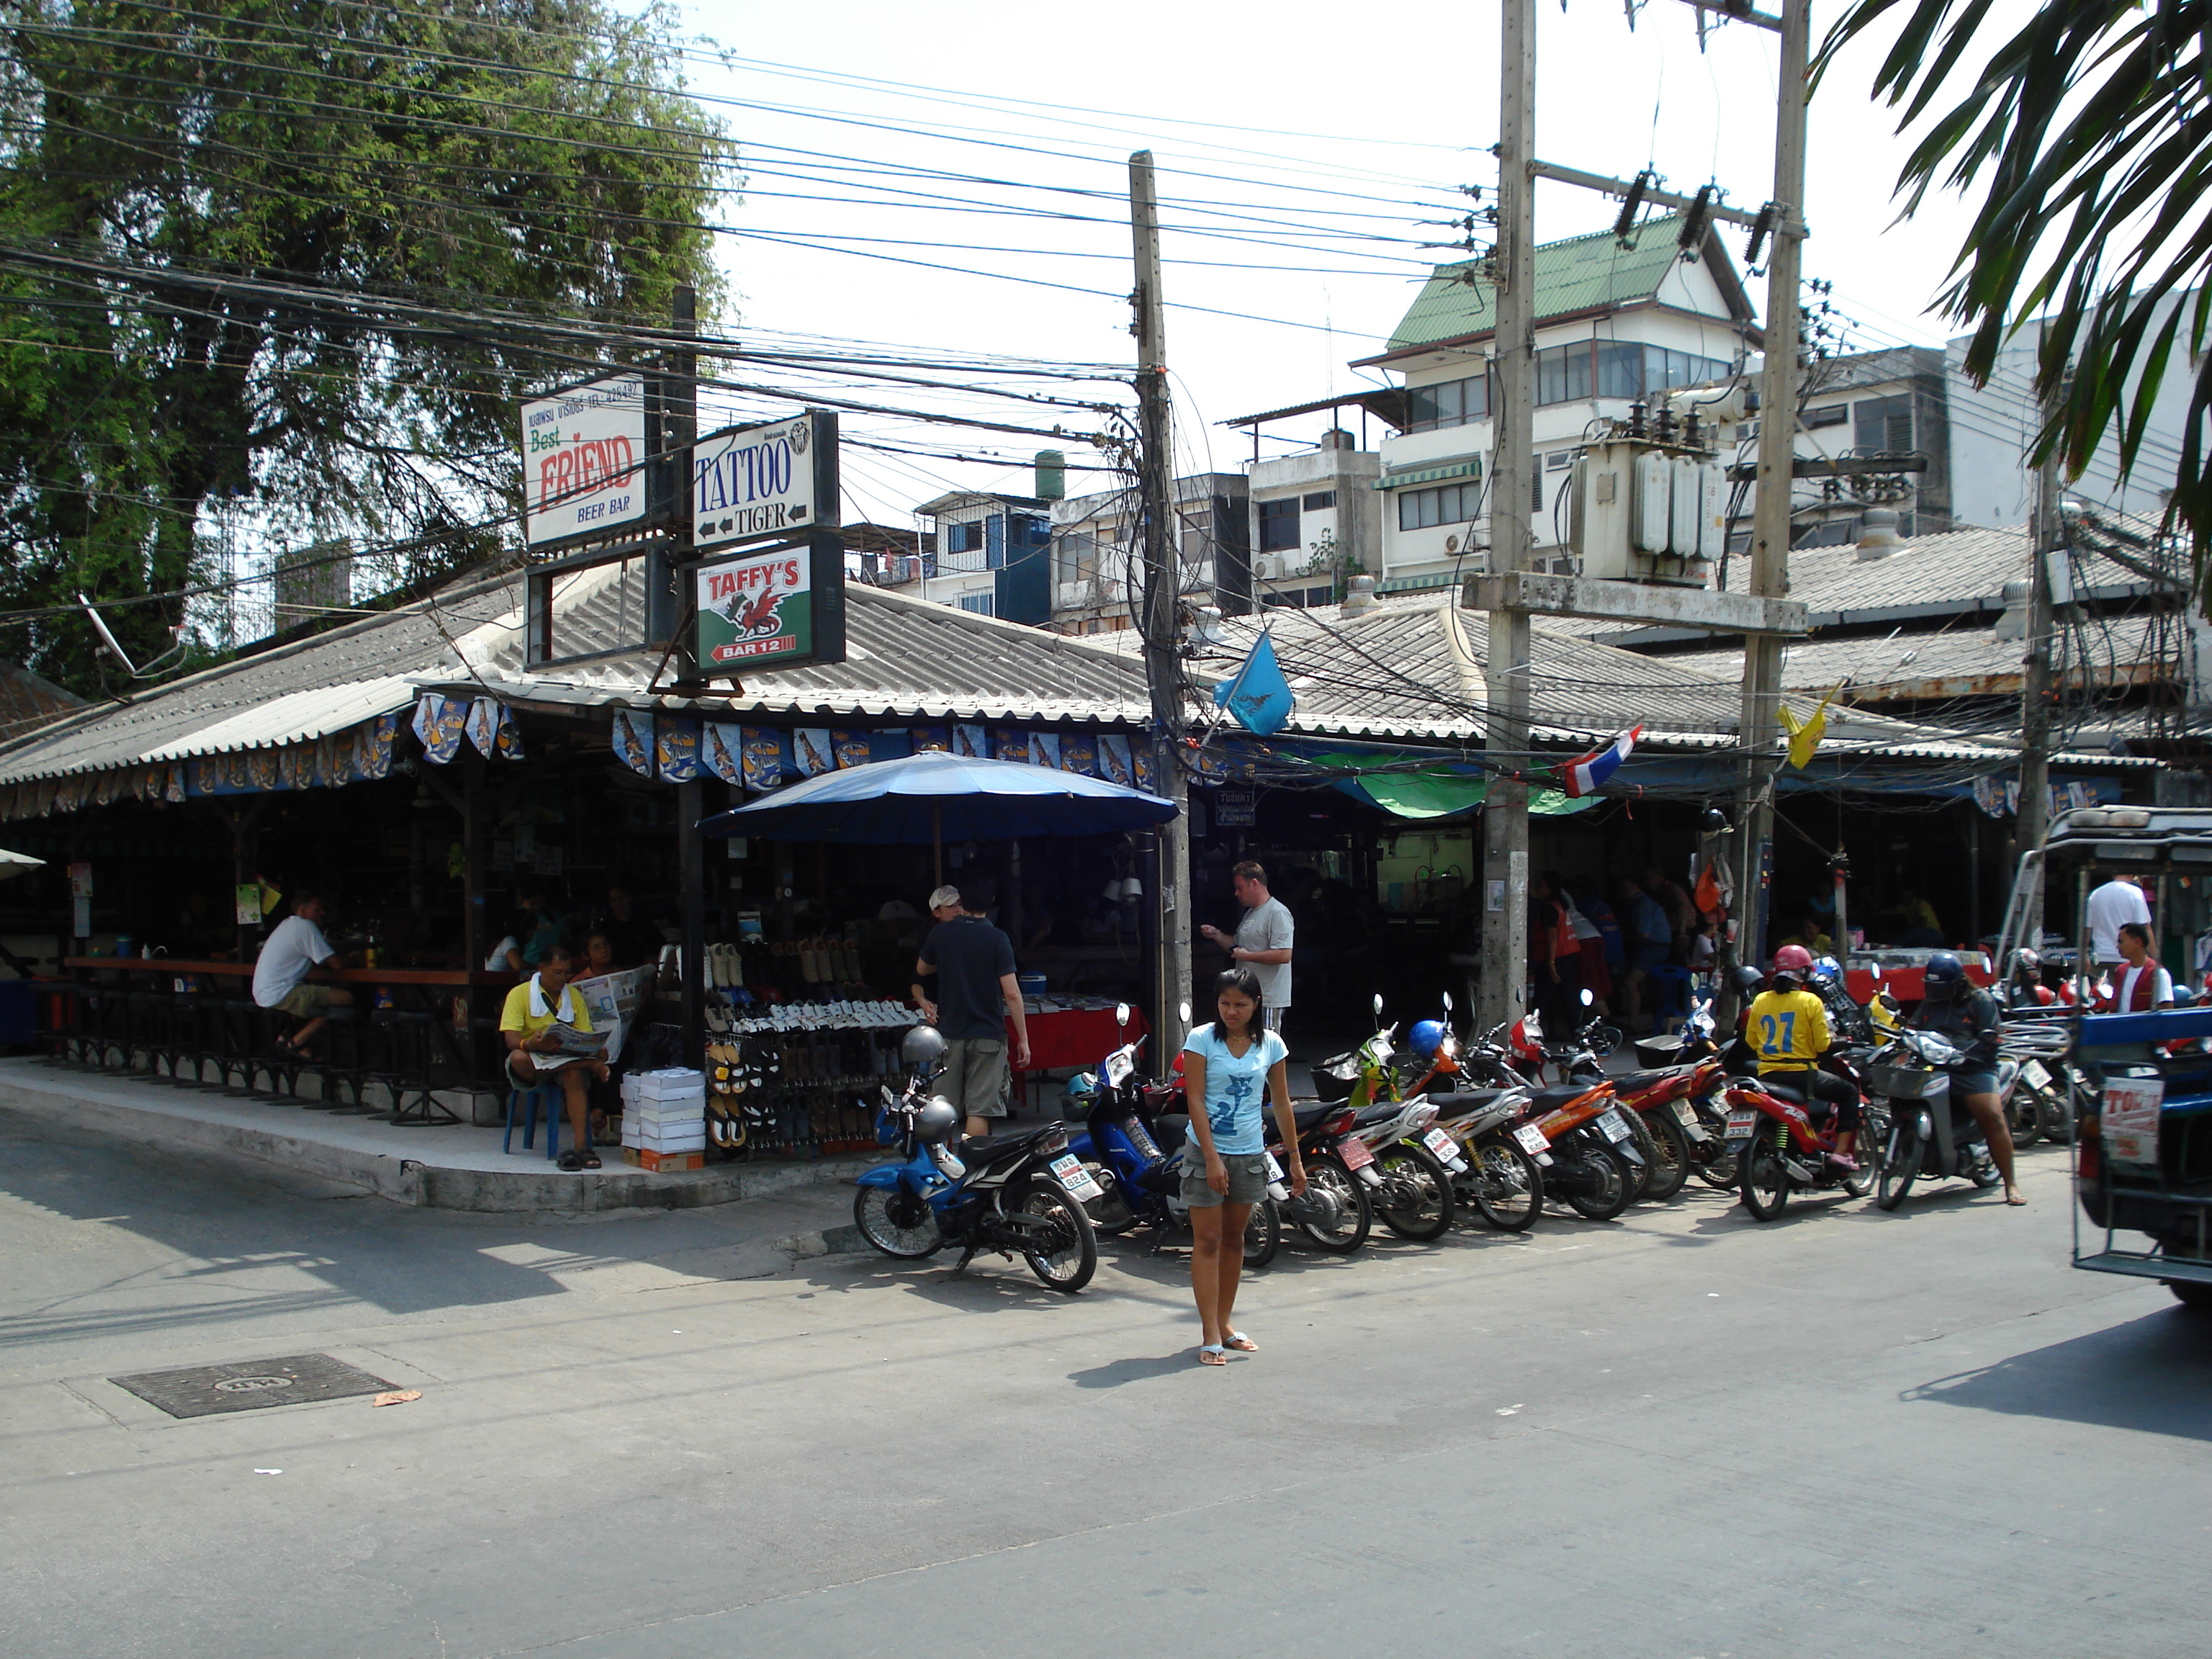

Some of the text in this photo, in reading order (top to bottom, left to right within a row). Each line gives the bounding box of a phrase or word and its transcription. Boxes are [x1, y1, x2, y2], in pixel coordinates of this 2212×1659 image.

[530, 426, 561, 453] Best
[696, 439, 791, 513] TATTOO
[577, 496, 630, 523] BEER BAR
[735, 503, 787, 535] TIGER
[708, 559, 799, 601] TAFFY'S
[722, 640, 780, 658] BAR 12
[1760, 1012, 1795, 1054] 27
[1729, 1128, 1748, 1136] 332
[1440, 1148, 1456, 1160] 335
[1529, 1141, 1546, 1152] 640
[1066, 1173, 1087, 1187] 824
